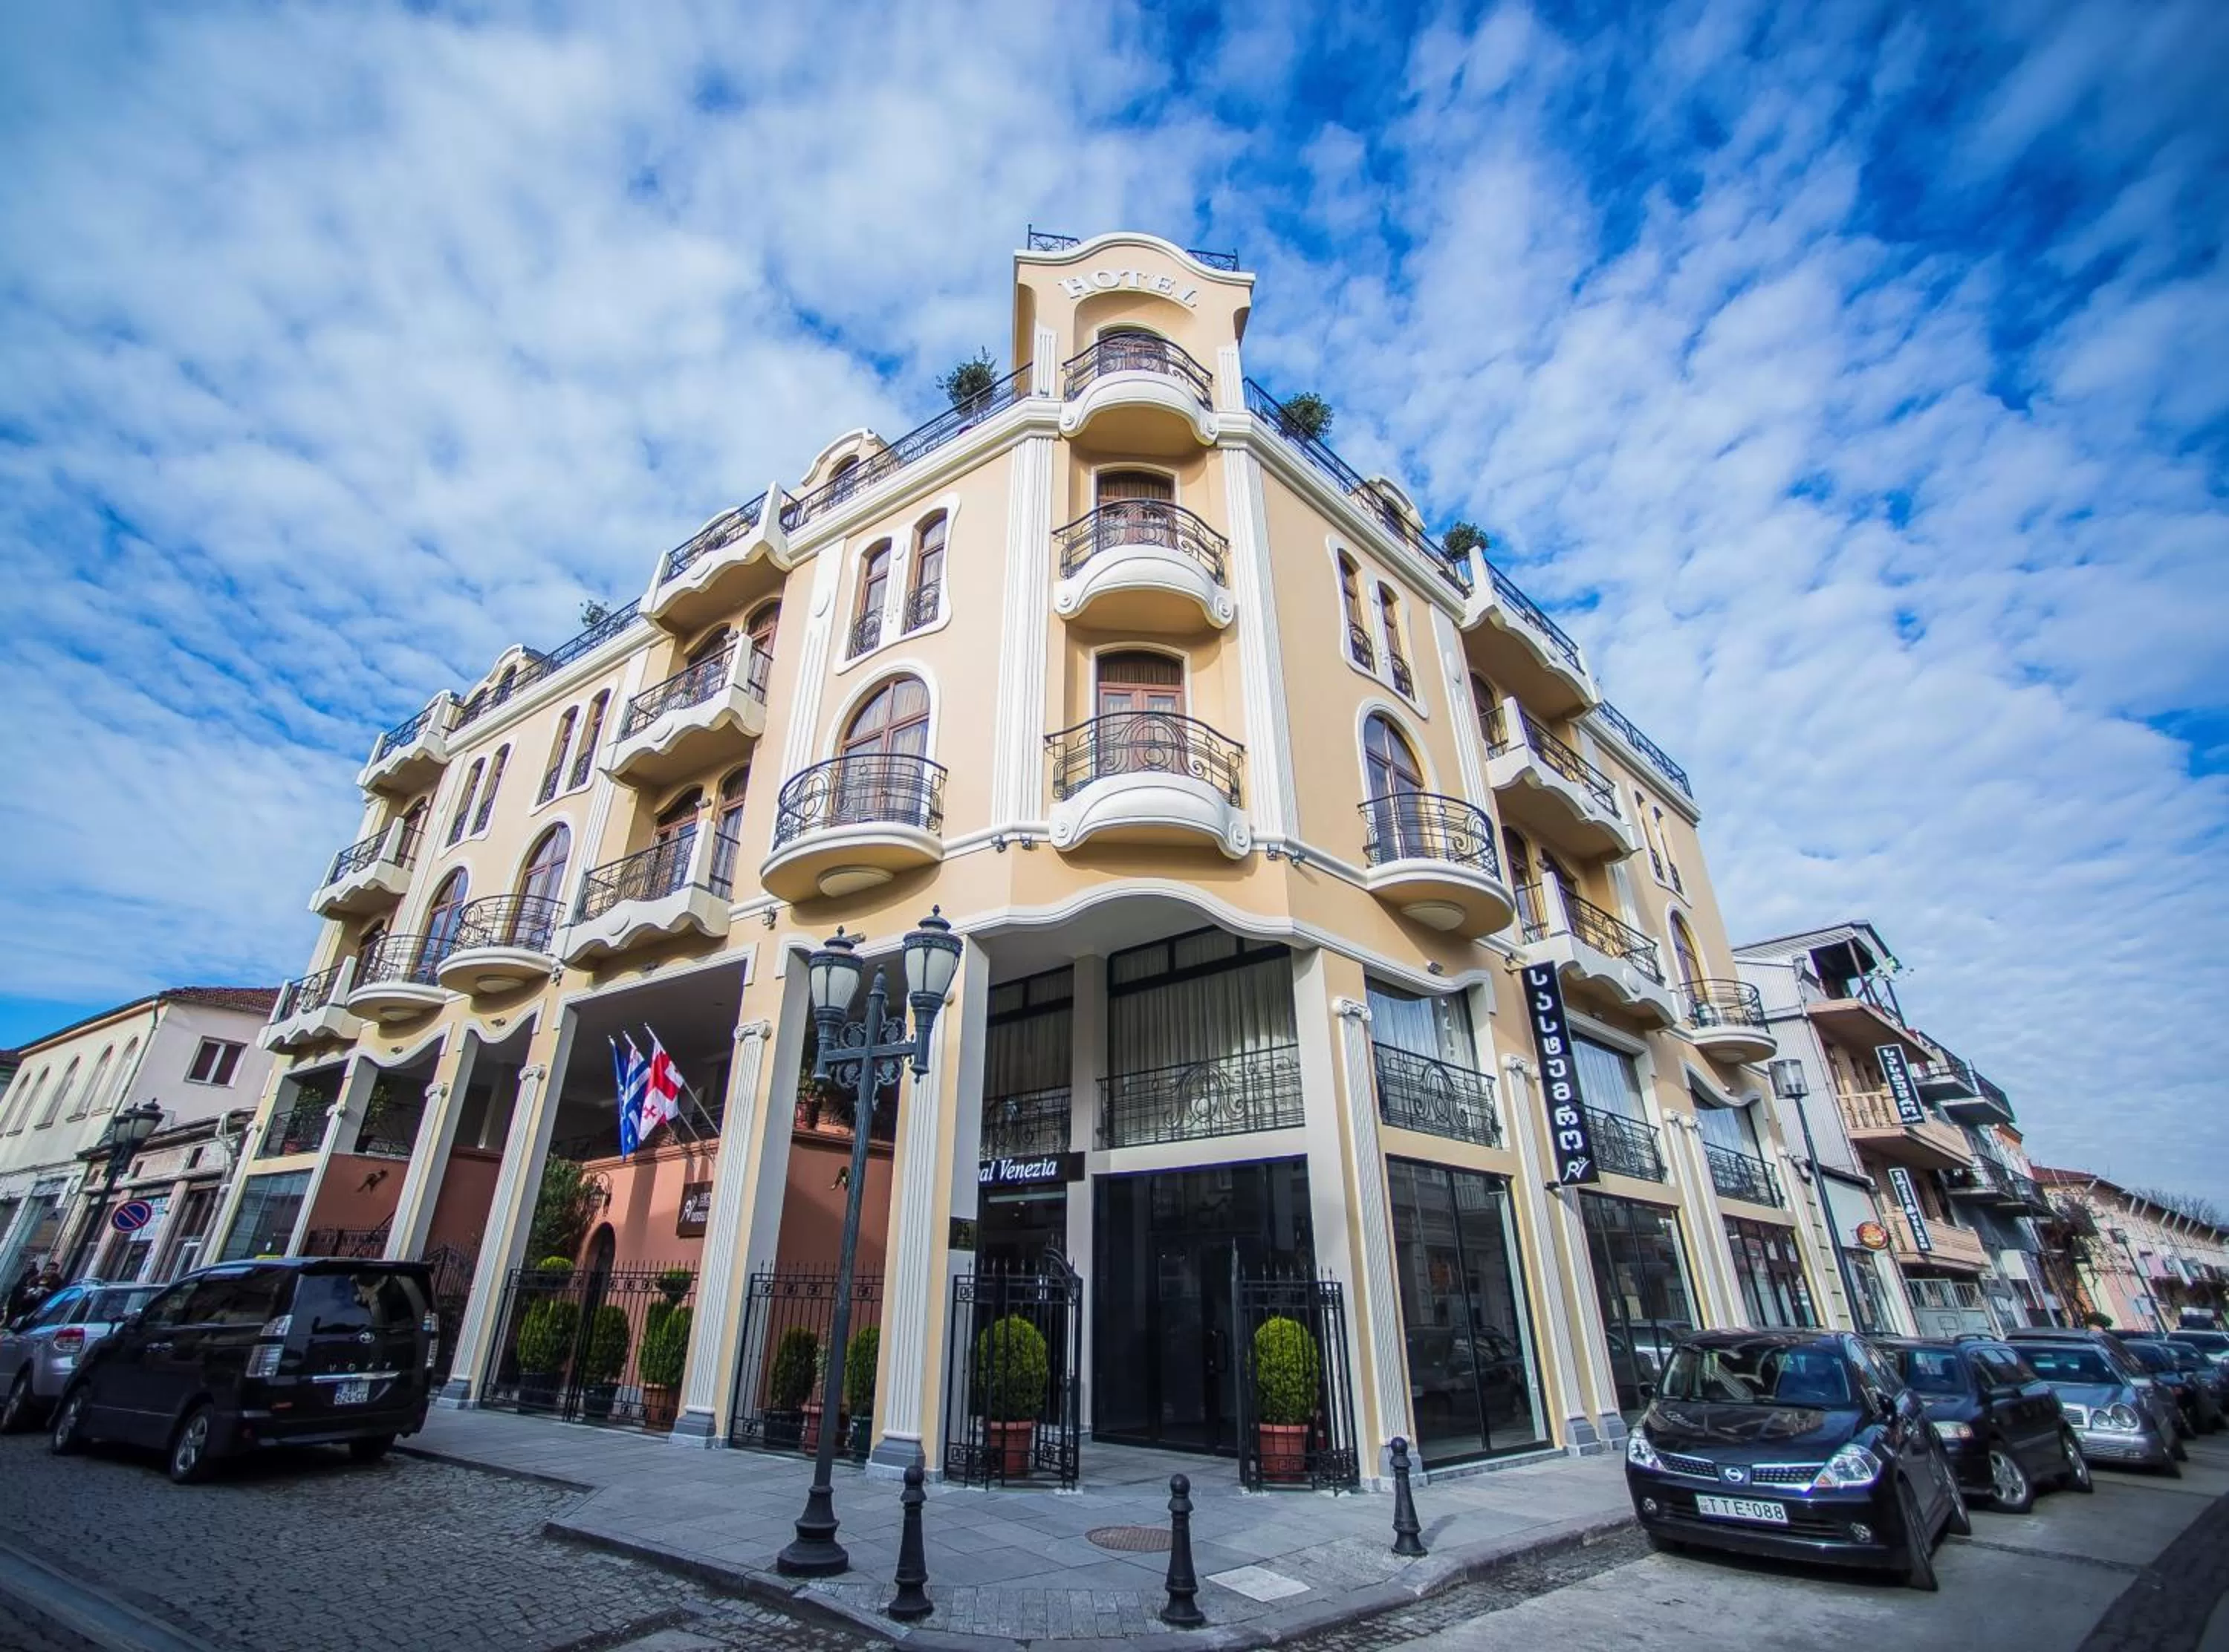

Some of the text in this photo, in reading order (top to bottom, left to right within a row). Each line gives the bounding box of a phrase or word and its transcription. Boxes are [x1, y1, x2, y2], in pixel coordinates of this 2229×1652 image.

[1057, 269, 1198, 308] HOTEL
[1529, 969, 1583, 1151] სასტუმრო
[999, 1157, 1057, 1180] Venezia
